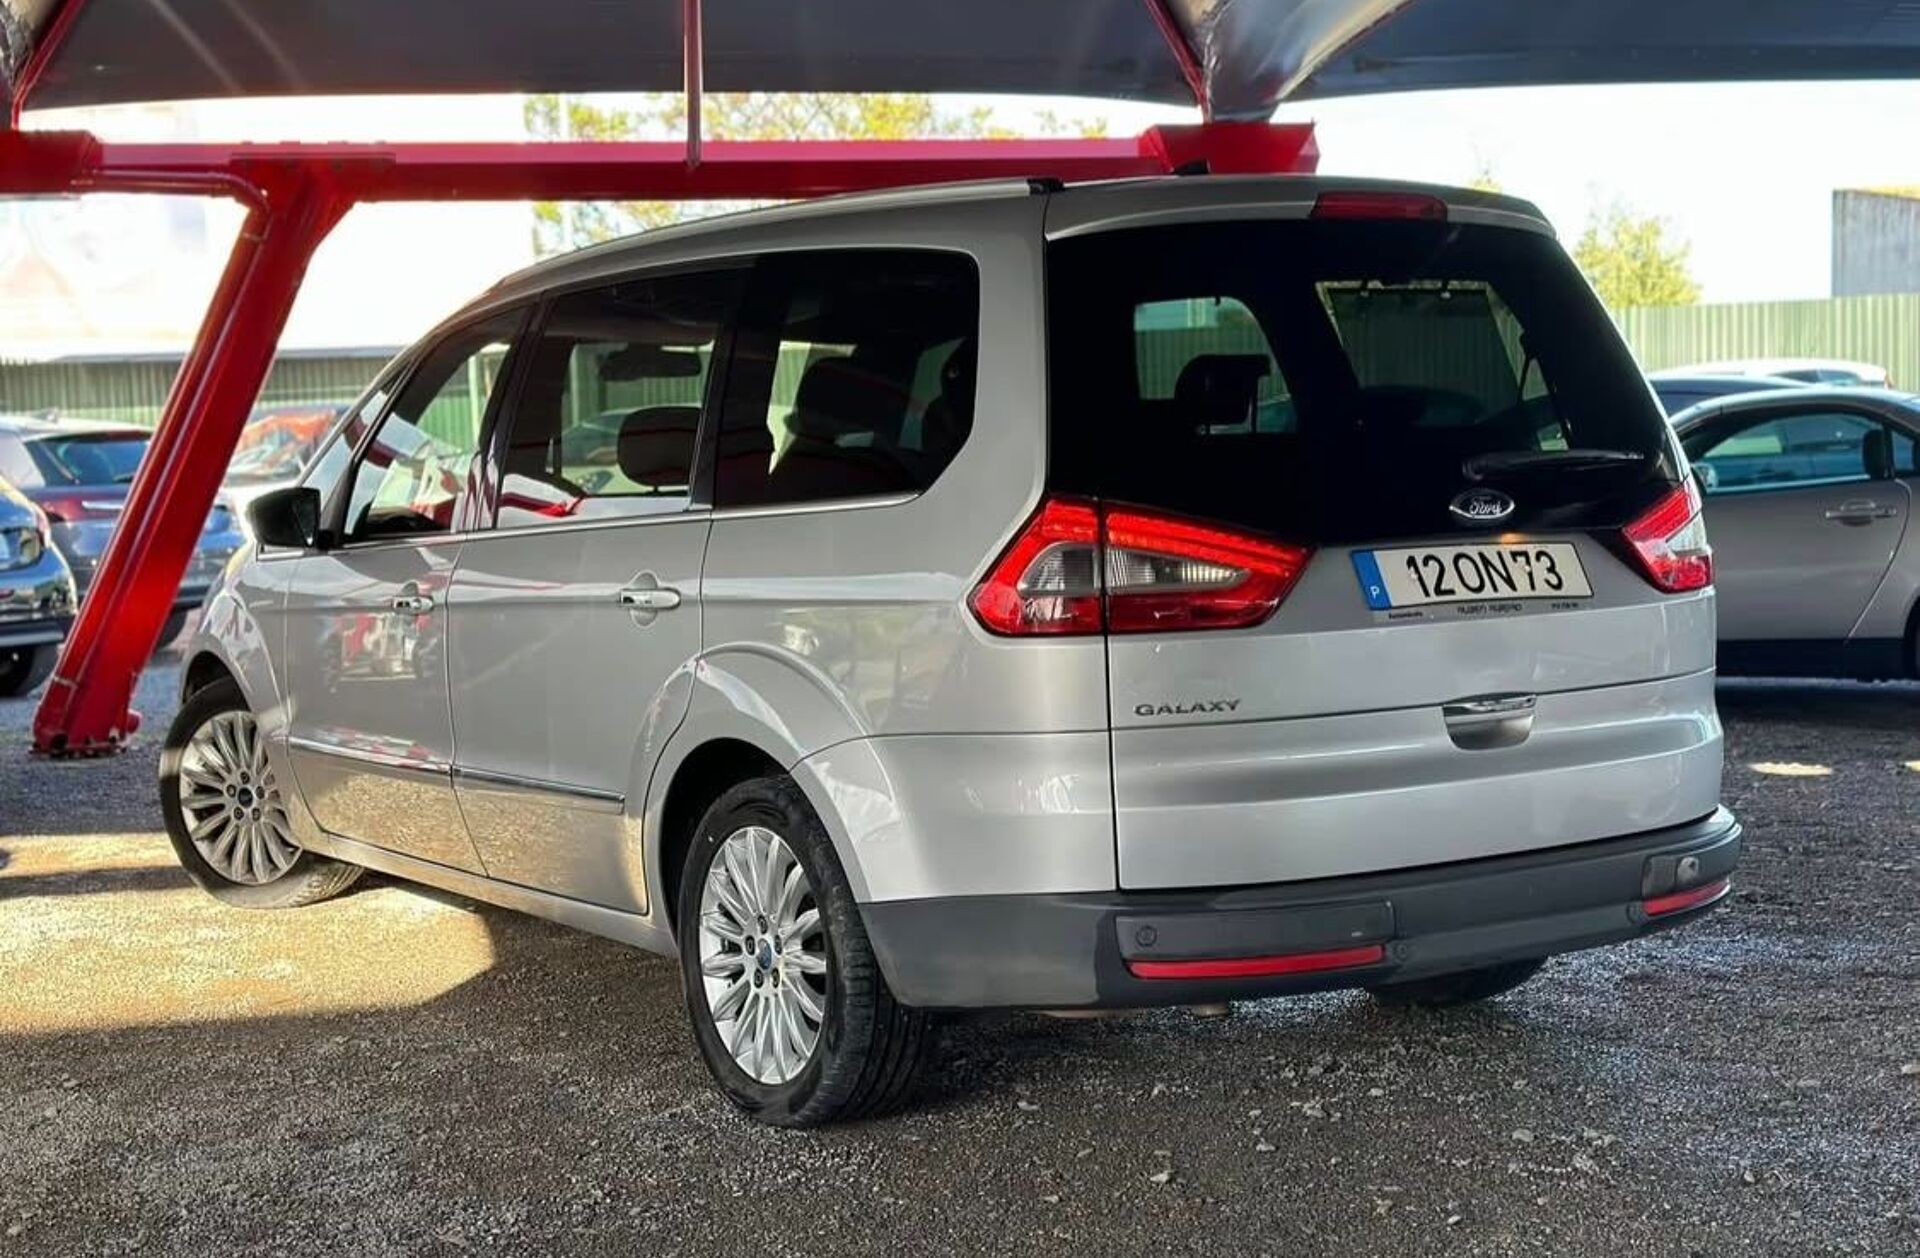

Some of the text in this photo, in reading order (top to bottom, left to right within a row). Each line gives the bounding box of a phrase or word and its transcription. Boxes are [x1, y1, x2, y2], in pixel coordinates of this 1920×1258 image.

[1469, 496, 1502, 514] Ford
[1370, 585, 1380, 599] P
[1134, 699, 1241, 716] GALAXY
